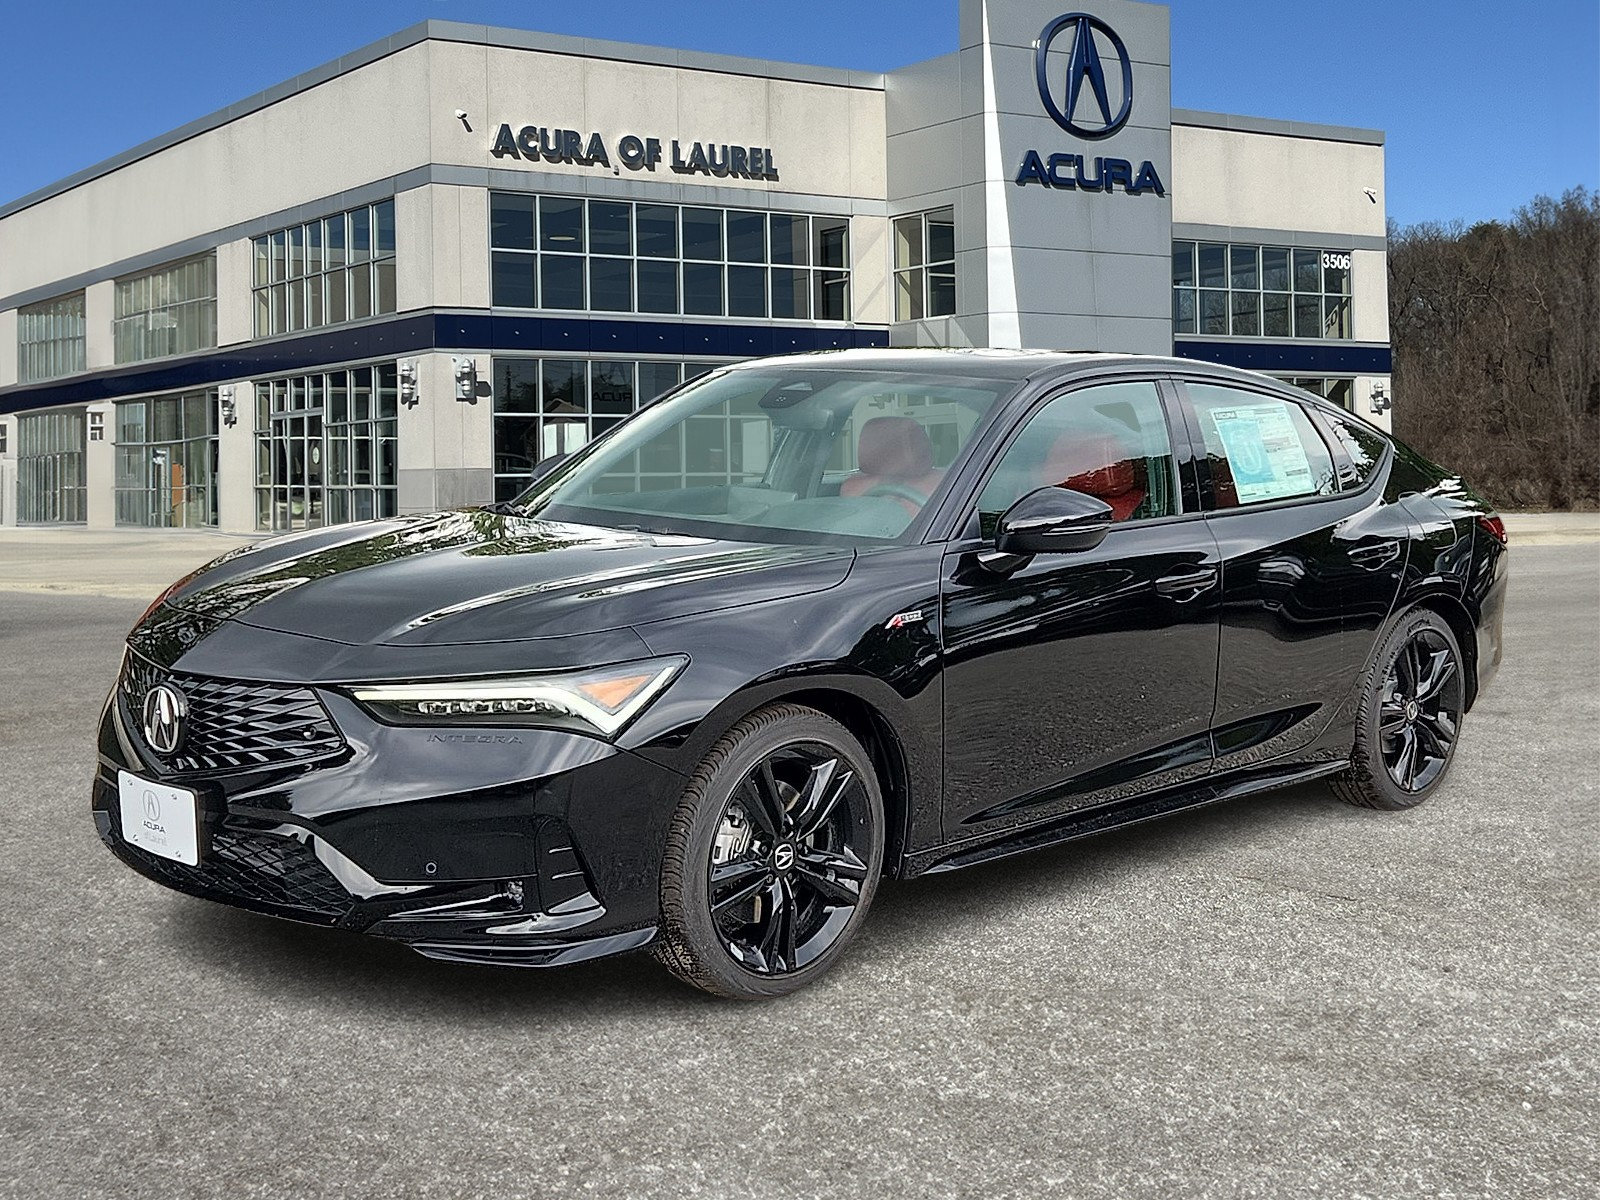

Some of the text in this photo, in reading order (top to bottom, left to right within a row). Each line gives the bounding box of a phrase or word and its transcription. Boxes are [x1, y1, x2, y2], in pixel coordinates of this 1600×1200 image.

[491, 123, 779, 181] ACURA OF LAUREL
[1015, 150, 1165, 198] ACURA
[1322, 253, 1350, 270] 3506
[426, 733, 523, 745] INTEGRA
[143, 820, 166, 834] ACURA
